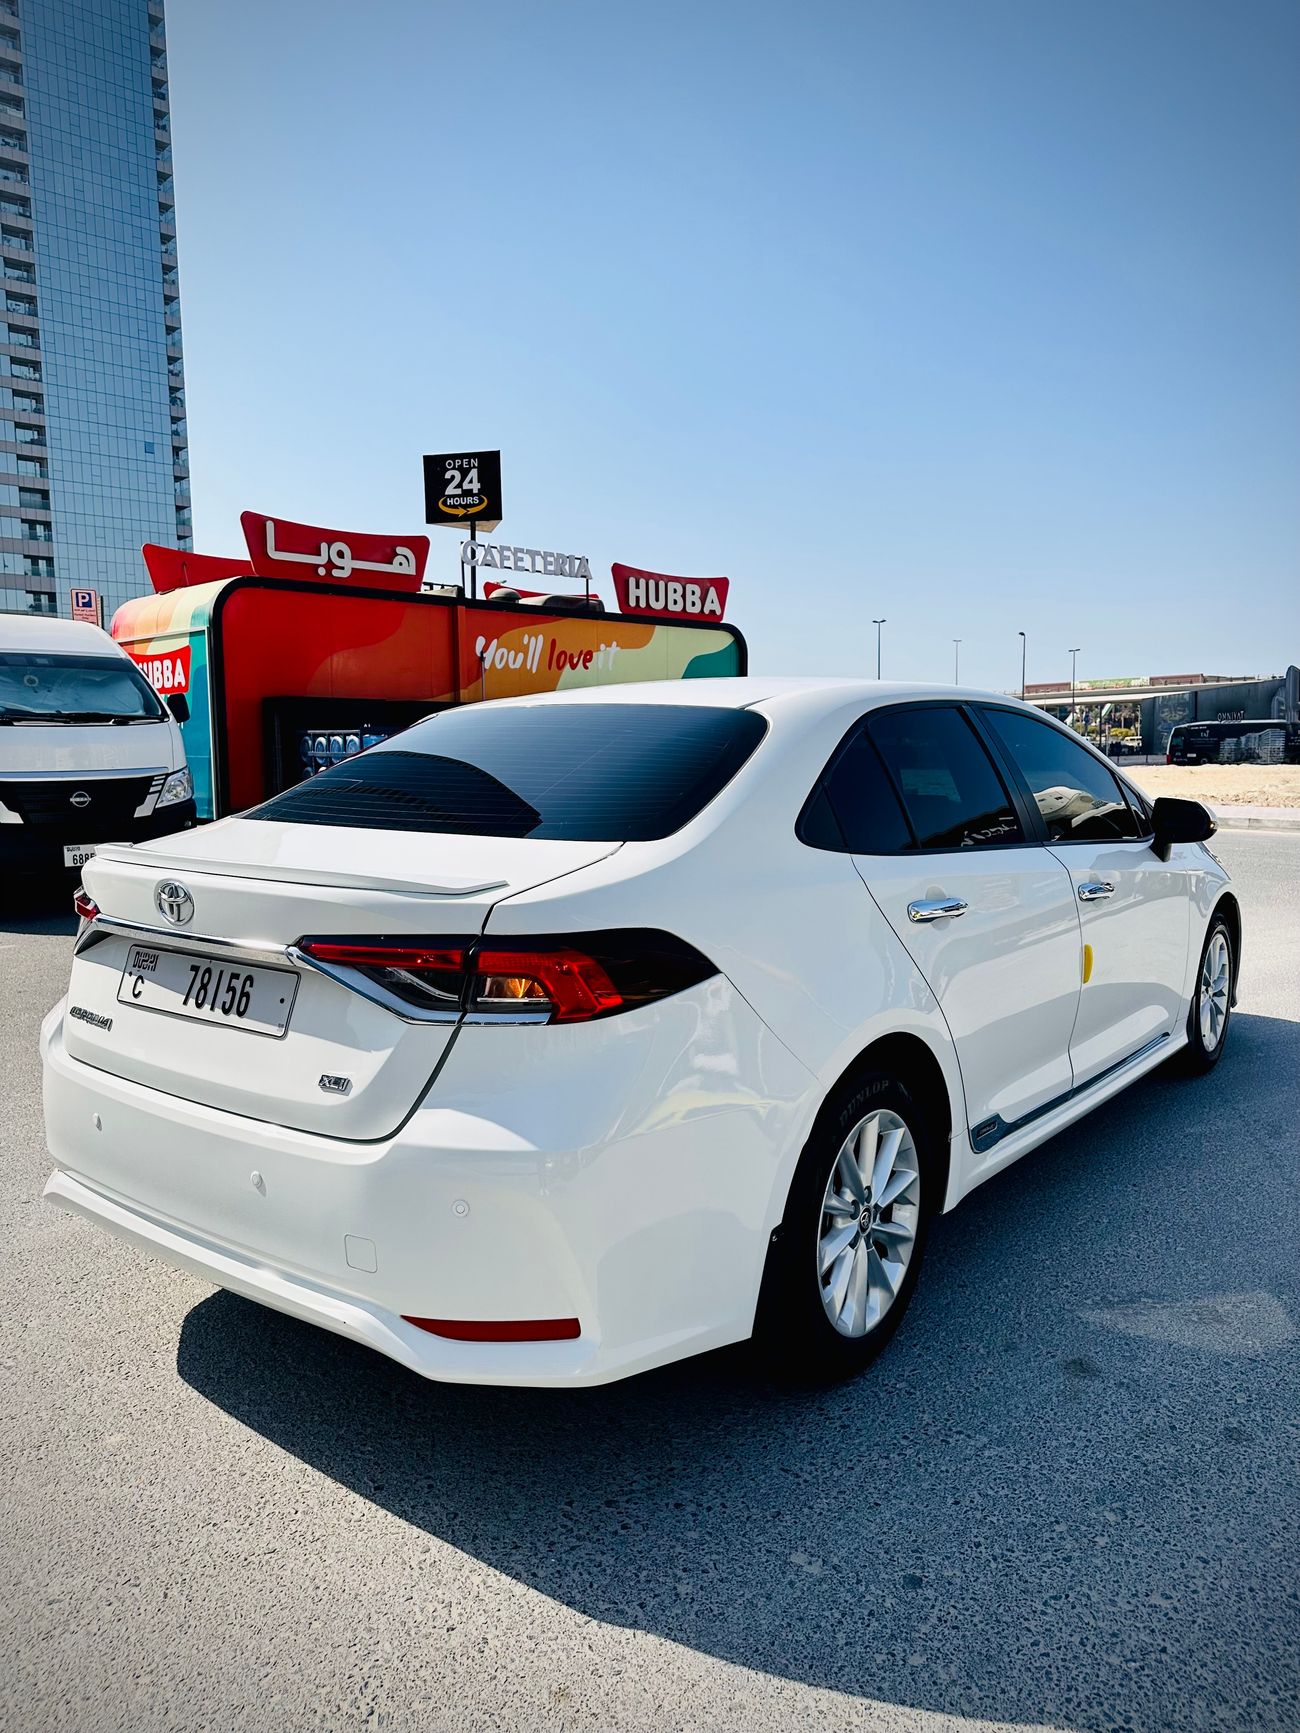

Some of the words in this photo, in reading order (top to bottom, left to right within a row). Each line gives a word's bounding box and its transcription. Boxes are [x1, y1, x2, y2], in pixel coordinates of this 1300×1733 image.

[444, 468, 481, 496] 24
[445, 458, 478, 469] OPEN
[447, 496, 479, 506] HOURS
[266, 520, 416, 578] هوبا
[461, 540, 593, 579] CAFETERIA
[77, 592, 90, 607] P
[628, 576, 722, 616] HUBBA
[475, 634, 544, 674] You'll
[547, 638, 594, 671] love
[597, 640, 622, 671] it
[132, 975, 144, 999] C
[183, 964, 254, 1018] 78156
